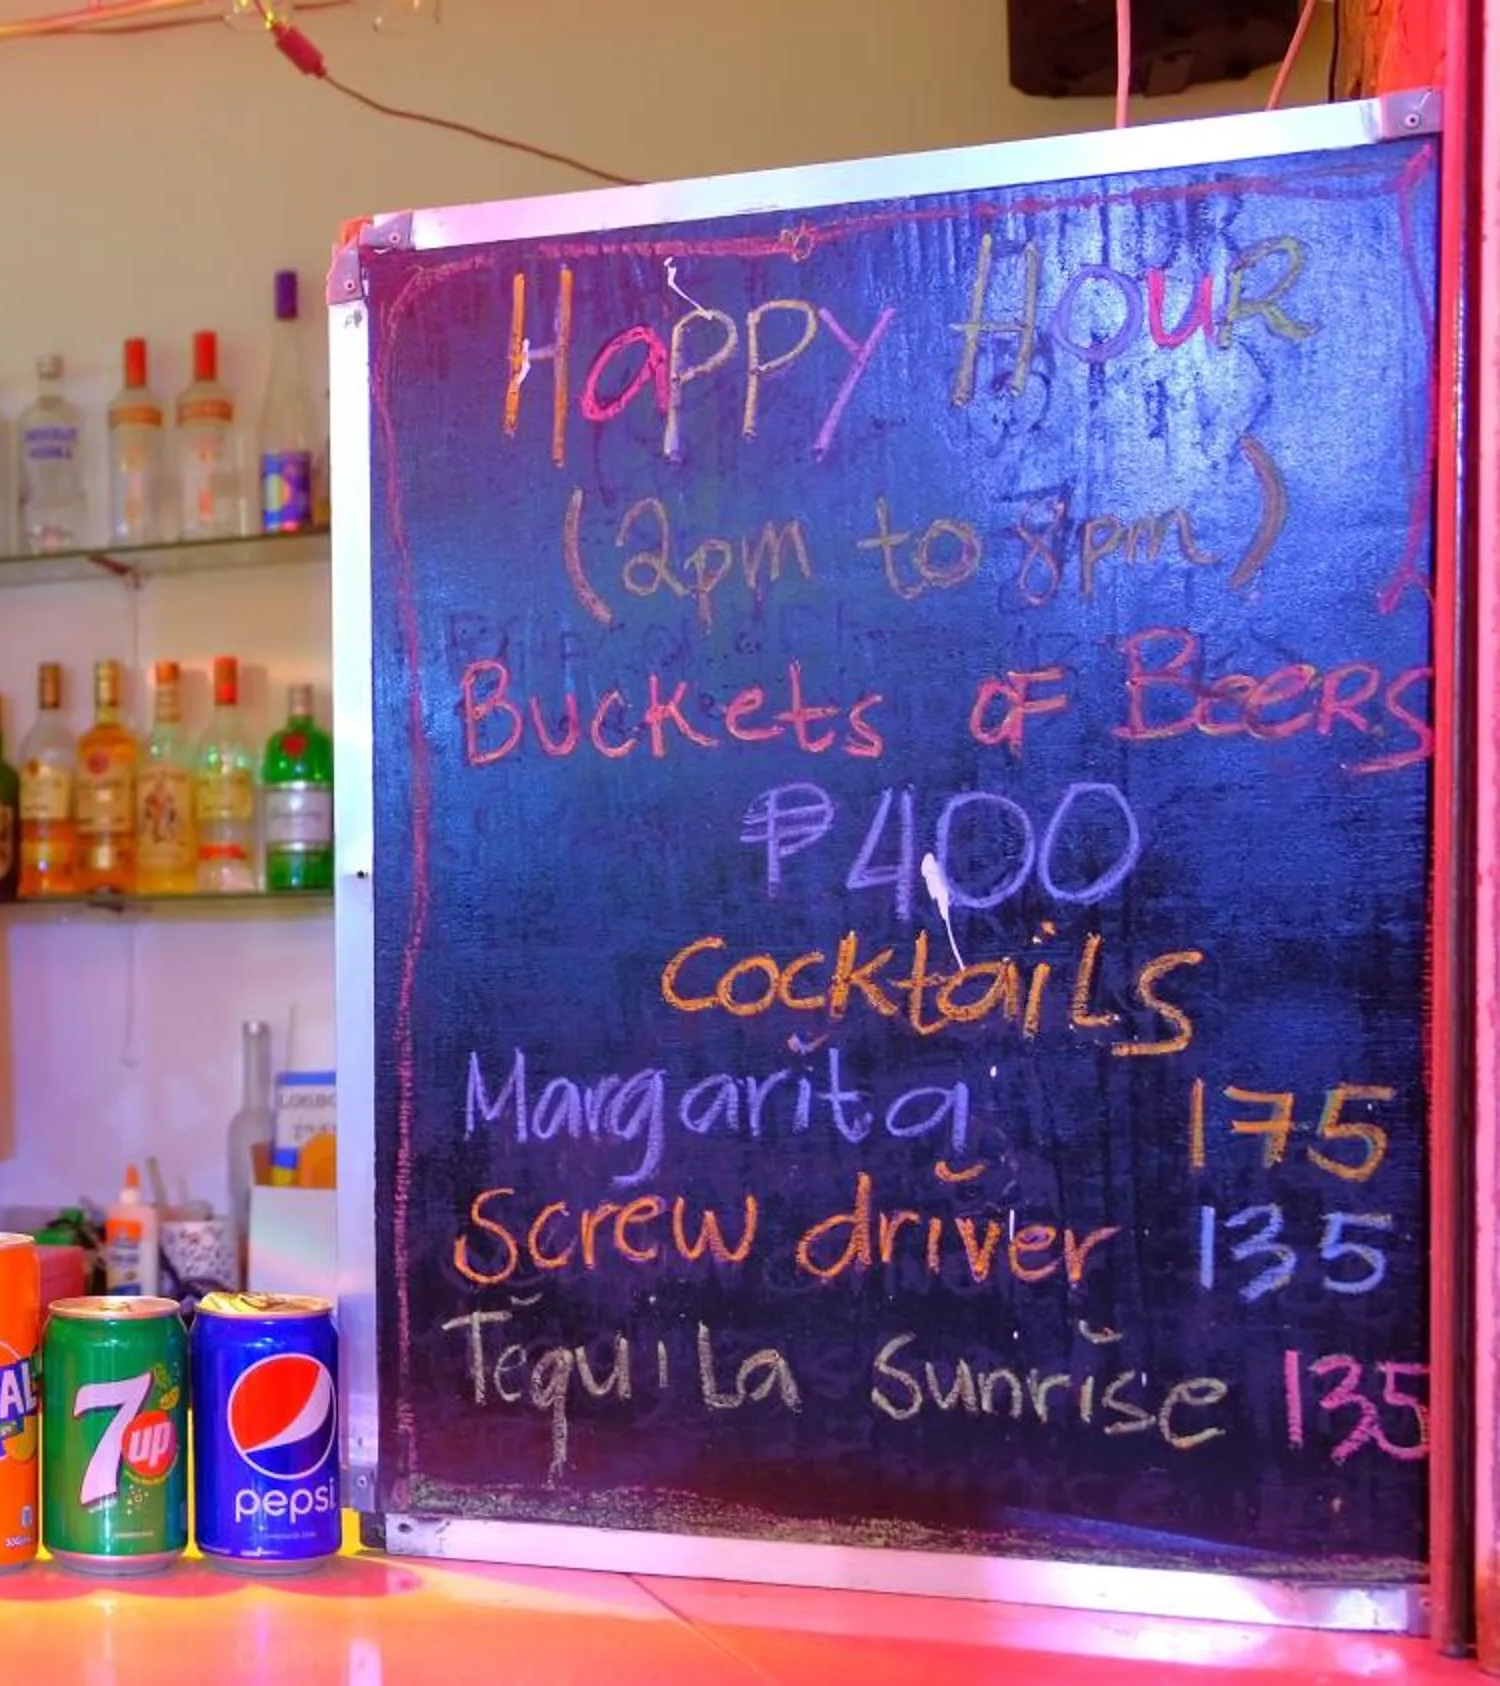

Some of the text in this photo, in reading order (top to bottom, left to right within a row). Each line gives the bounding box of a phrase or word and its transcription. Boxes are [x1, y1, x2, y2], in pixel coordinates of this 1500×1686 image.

[858, 496, 982, 601] to
[462, 1036, 1397, 1184] Margarita 175
[453, 1170, 1395, 1303] Screw driver 135
[72, 1372, 154, 1506] 7
[1282, 1347, 1434, 1465] 135
[234, 1479, 337, 1523] pepsi
